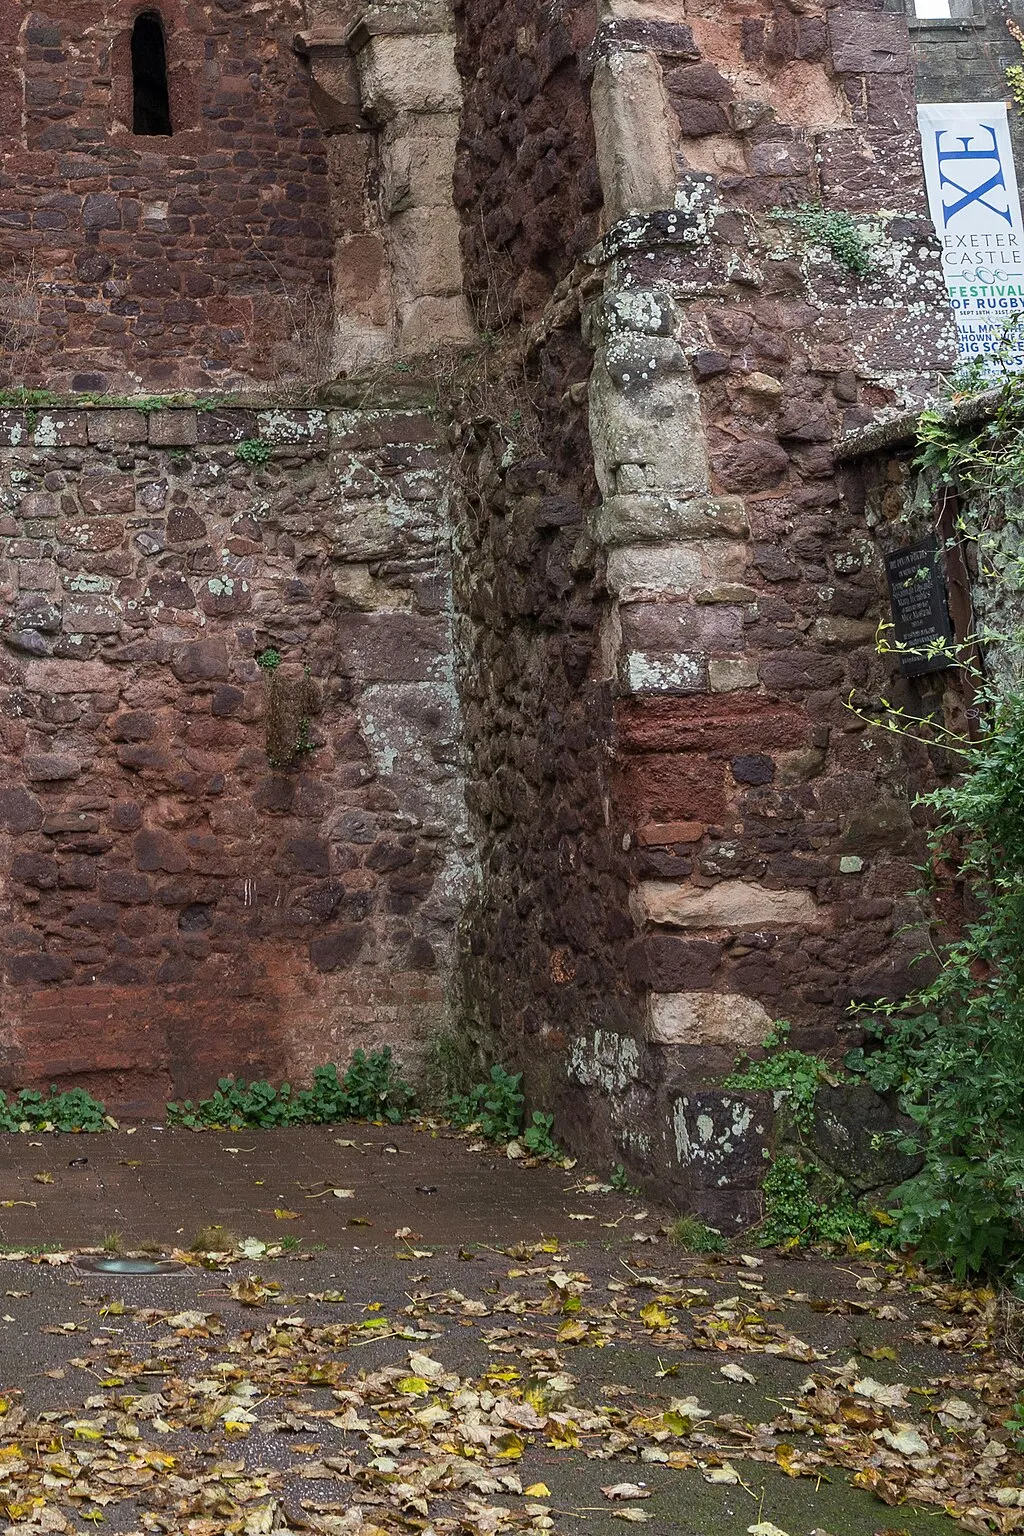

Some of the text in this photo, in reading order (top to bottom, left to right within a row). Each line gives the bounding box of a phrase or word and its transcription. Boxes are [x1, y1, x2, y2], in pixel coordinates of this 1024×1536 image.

[944, 233, 1019, 248] EXETER
[944, 250, 1022, 265] CASTLE
[949, 284, 1024, 297] FESTIVAL
[951, 298, 970, 309] OF
[957, 325, 976, 334] ALL
[958, 342, 979, 353] BIG
